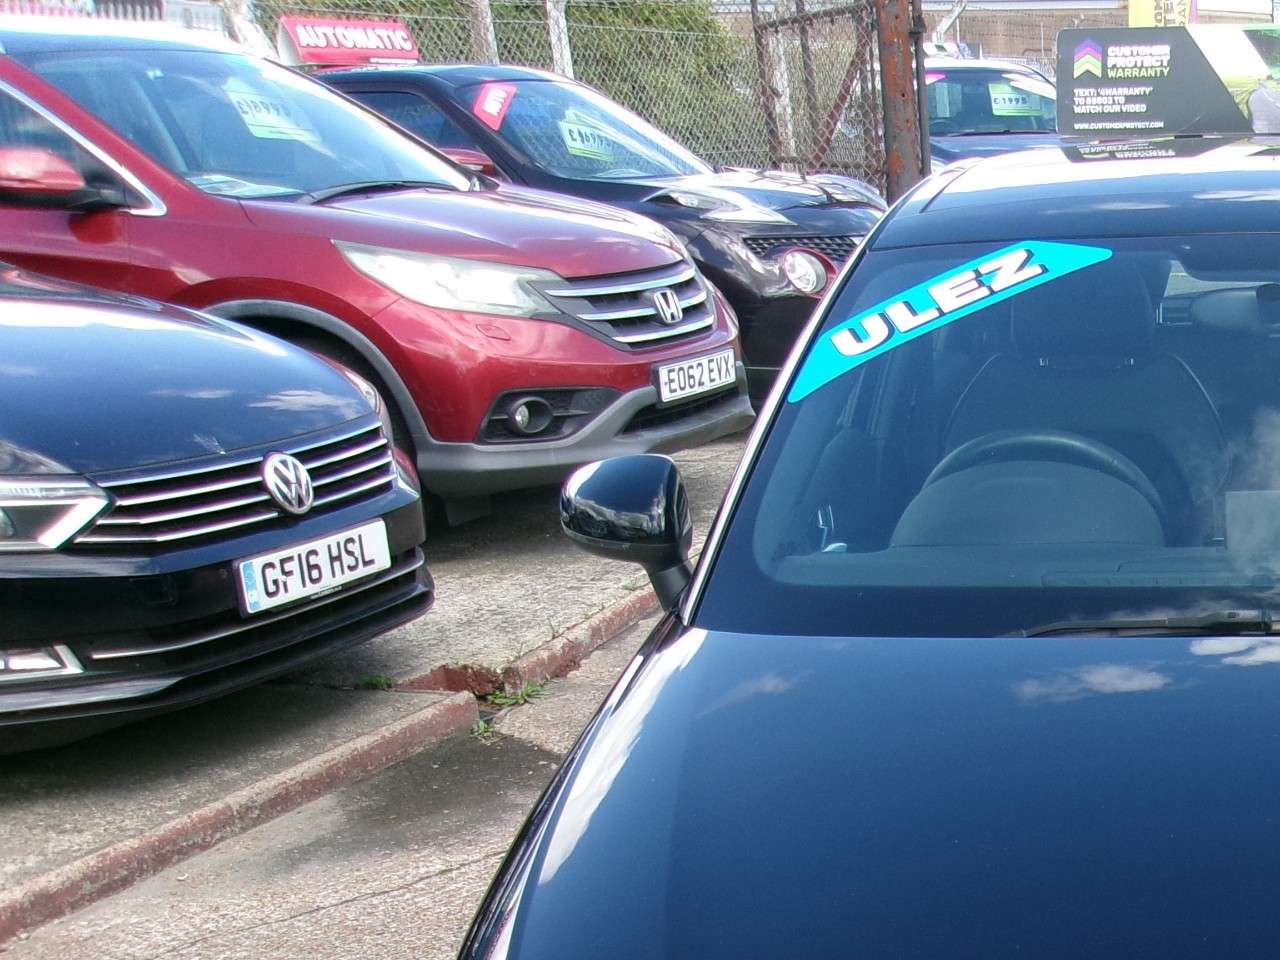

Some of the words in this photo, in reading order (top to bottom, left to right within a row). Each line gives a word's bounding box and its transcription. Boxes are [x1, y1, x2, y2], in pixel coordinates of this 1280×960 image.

[296, 25, 412, 50] AUTOMATIC
[1107, 45, 1171, 57] CUSTOMER
[1107, 56, 1171, 68] PROTECT
[1107, 67, 1170, 78] WARRANTY
[1114, 96, 1126, 104] TO
[1073, 106, 1102, 114] WATCH
[1103, 105, 1121, 113] OUR
[1121, 104, 1147, 113] VIDEO
[829, 248, 1050, 357] ULEZ
[707, 353, 732, 384] EVX
[261, 549, 323, 599] GF16
[327, 534, 376, 579] HSL
